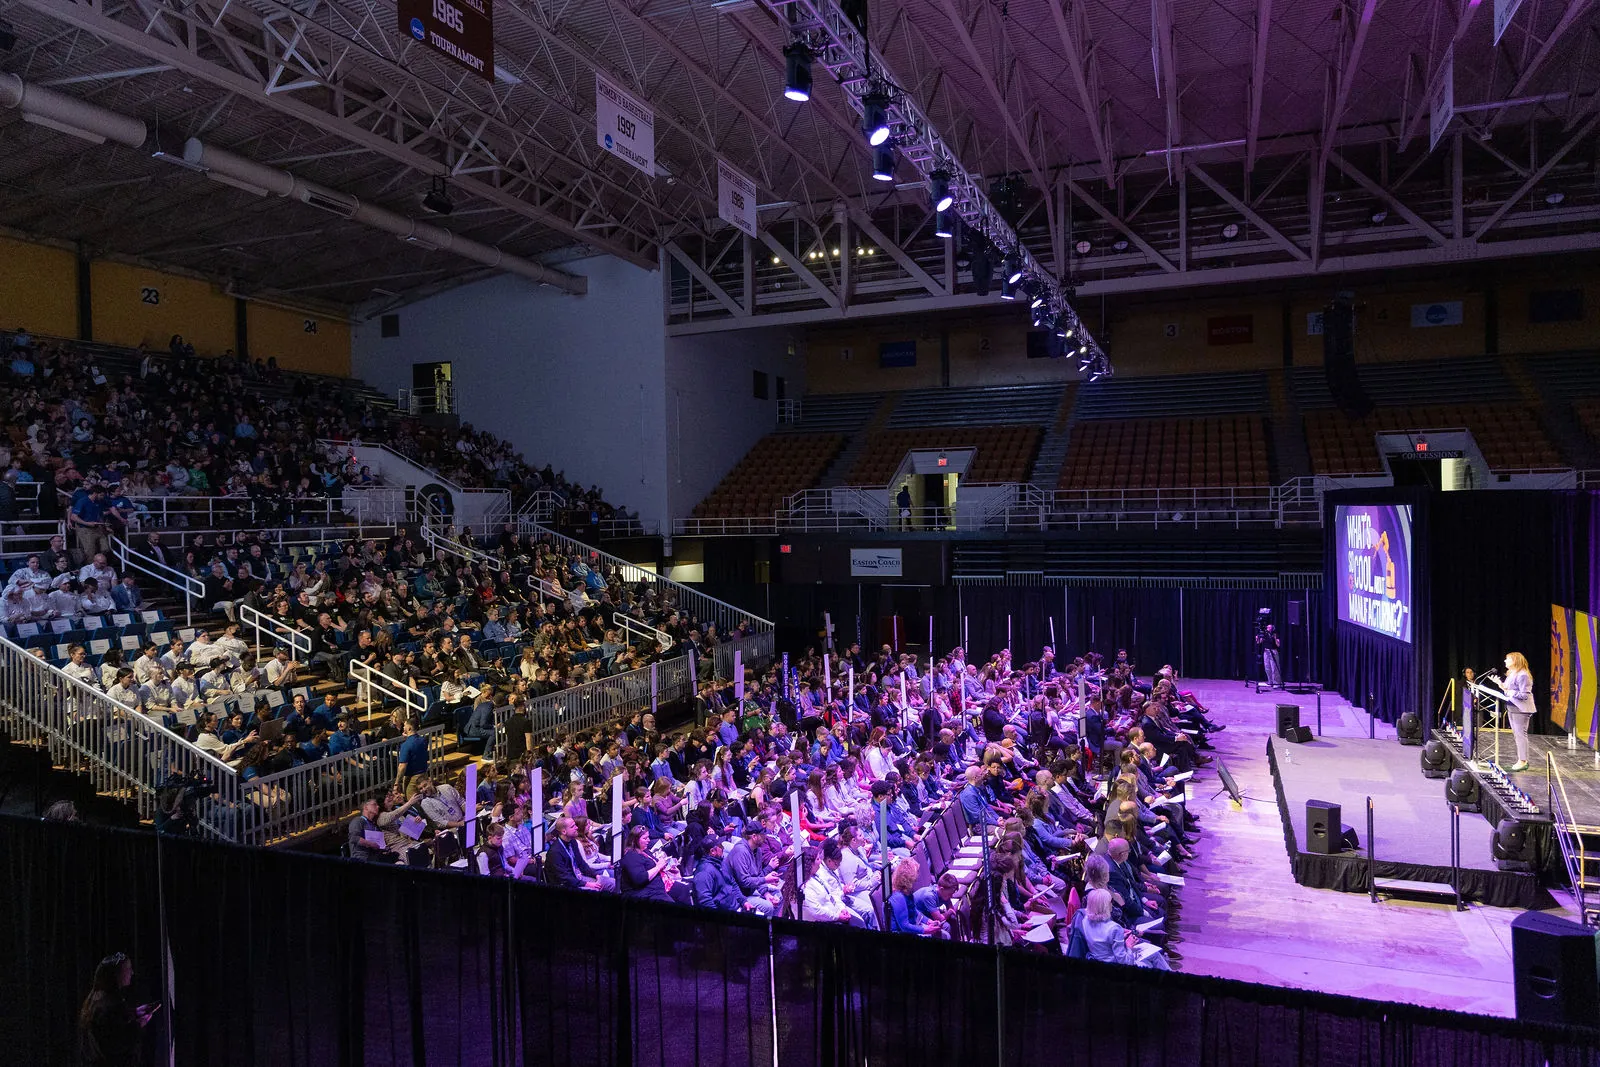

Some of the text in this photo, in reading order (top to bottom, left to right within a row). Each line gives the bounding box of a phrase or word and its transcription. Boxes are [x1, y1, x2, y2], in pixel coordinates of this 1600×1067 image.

[432, 0, 464, 34] 1985
[430, 31, 485, 72] TOURNAMENT
[598, 80, 652, 123] WOMEN'S BASKETBALL
[617, 114, 636, 141] 1997
[616, 141, 648, 169] TOURNAMENT
[141, 287, 159, 304] 23
[304, 320, 317, 334] 24
[1166, 325, 1176, 337] 3
[980, 338, 990, 350] 2
[1416, 443, 1427, 452] EXIT
[1347, 512, 1371, 550] WHAT'S
[1348, 550, 1385, 594] SO COOL ABOUT
[1349, 593, 1402, 637] MANUFACTURING?
